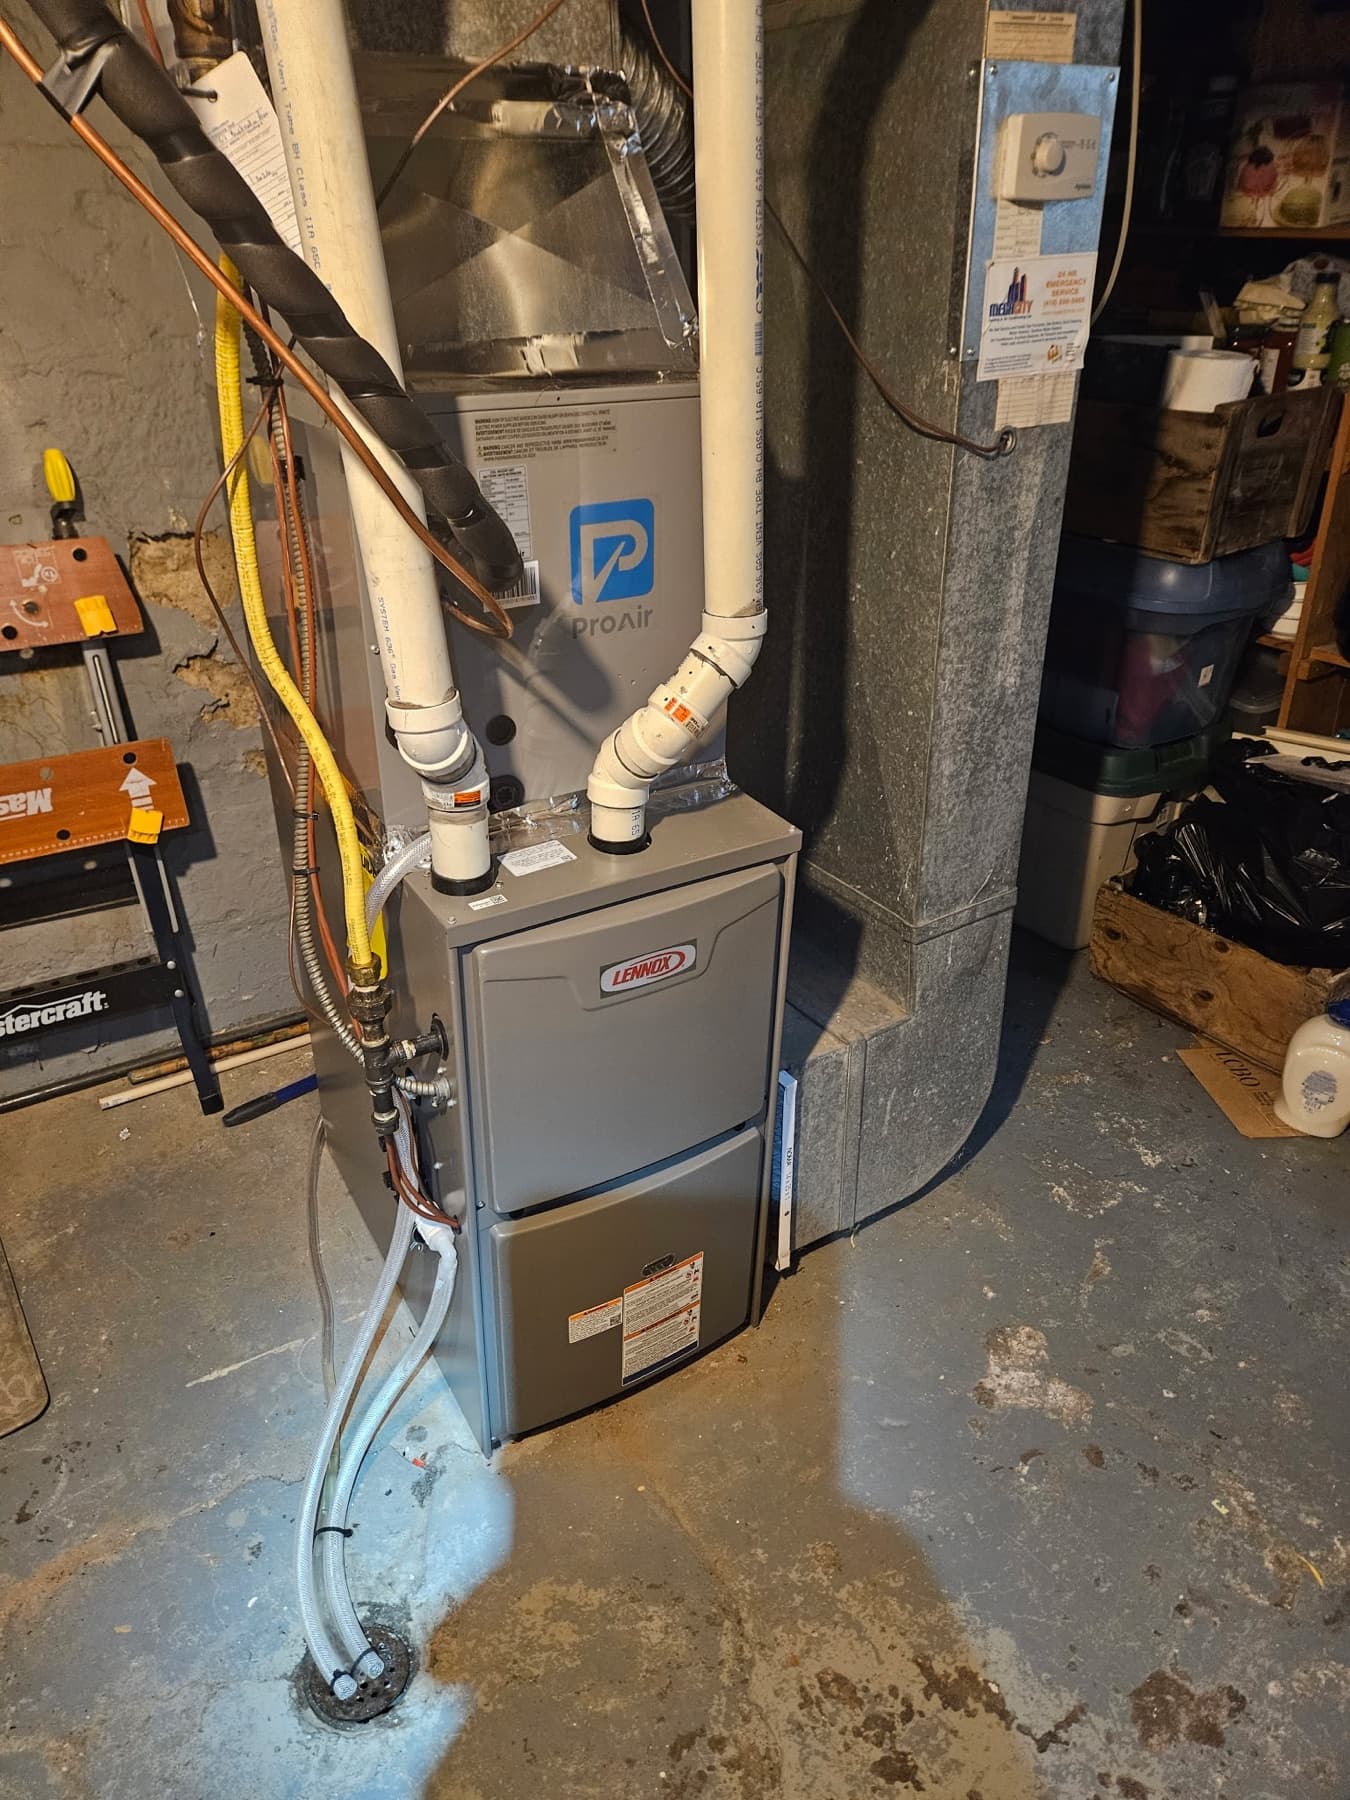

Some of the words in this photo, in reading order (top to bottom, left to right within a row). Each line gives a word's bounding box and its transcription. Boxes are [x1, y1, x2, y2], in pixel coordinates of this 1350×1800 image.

[277, 59, 288, 92] Vent
[292, 143, 300, 159] BH
[296, 167, 308, 207] Class
[755, 168, 763, 192] 636
[755, 200, 763, 246] SYSTEM
[755, 429, 763, 463] CLASS
[612, 955, 673, 986] LENNOX
[1216, 1052, 1261, 1087] LCBO
